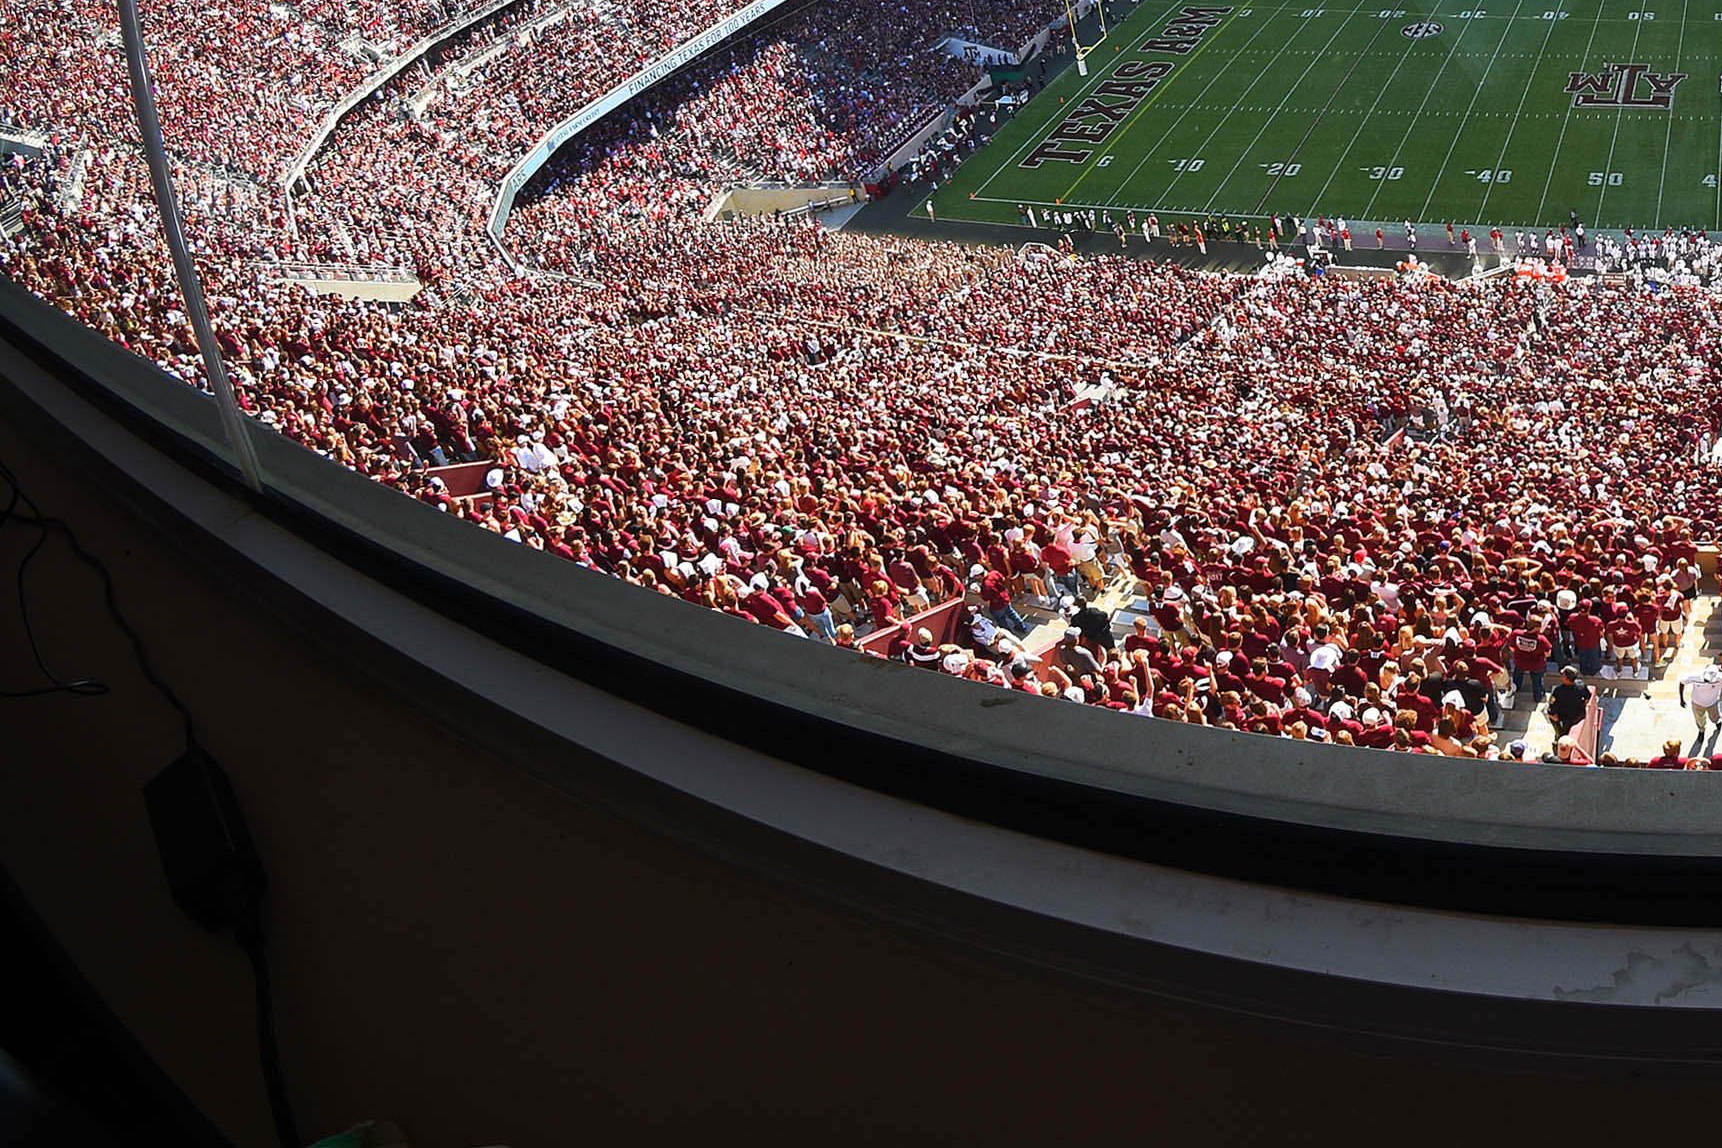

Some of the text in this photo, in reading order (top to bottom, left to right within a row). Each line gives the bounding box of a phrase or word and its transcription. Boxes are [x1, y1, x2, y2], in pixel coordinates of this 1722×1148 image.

[1627, 12, 1655, 21] 50
[628, 2, 767, 95] FINANCING TEXAS FOR 100 YEARS
[1017, 5, 1234, 169] TEXAS A&M
[1174, 159, 1205, 172] 10
[1266, 163, 1302, 177] 20
[1369, 166, 1405, 180] 30
[1477, 169, 1512, 183] 40
[1587, 172, 1623, 186] 50
